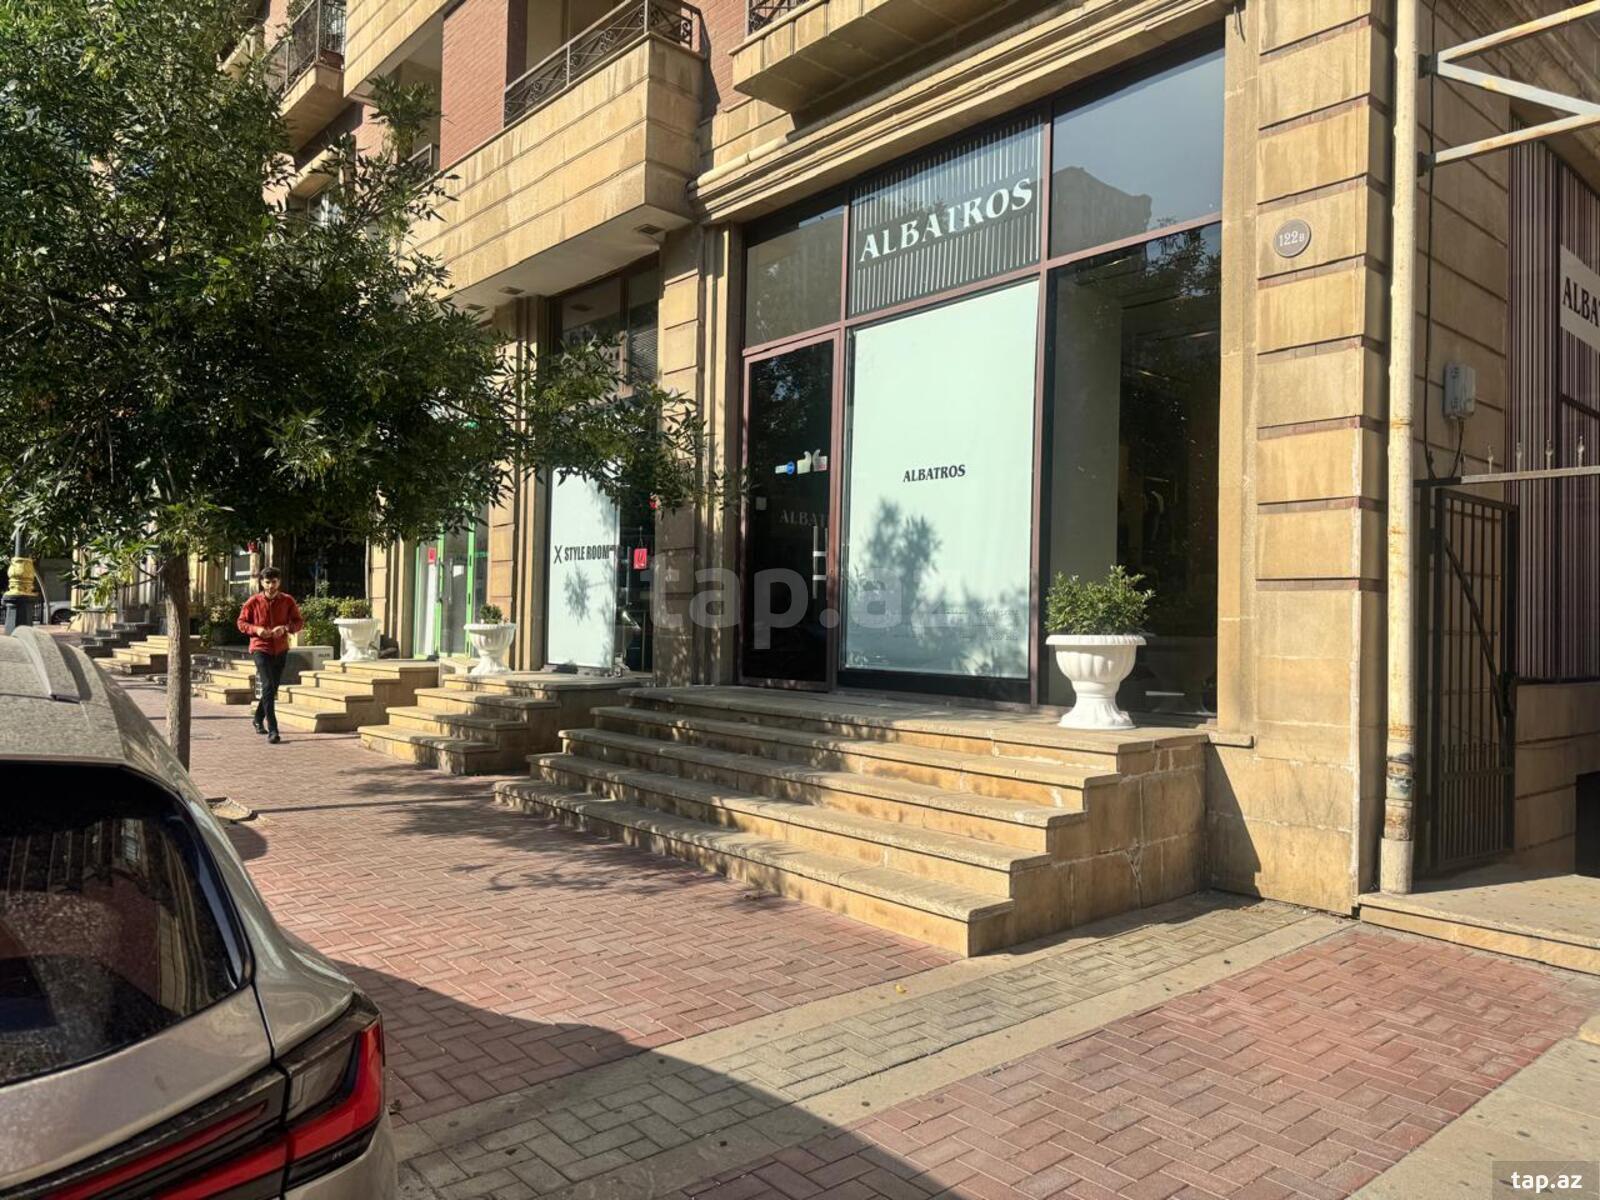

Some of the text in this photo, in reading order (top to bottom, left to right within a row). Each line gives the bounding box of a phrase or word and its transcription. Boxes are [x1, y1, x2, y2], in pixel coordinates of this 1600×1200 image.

[859, 178, 1032, 263] ALBATROS
[1562, 276, 1600, 328] ALBA
[903, 464, 966, 482] ALBATROS
[553, 544, 563, 564] X
[564, 546, 585, 561] STYLE
